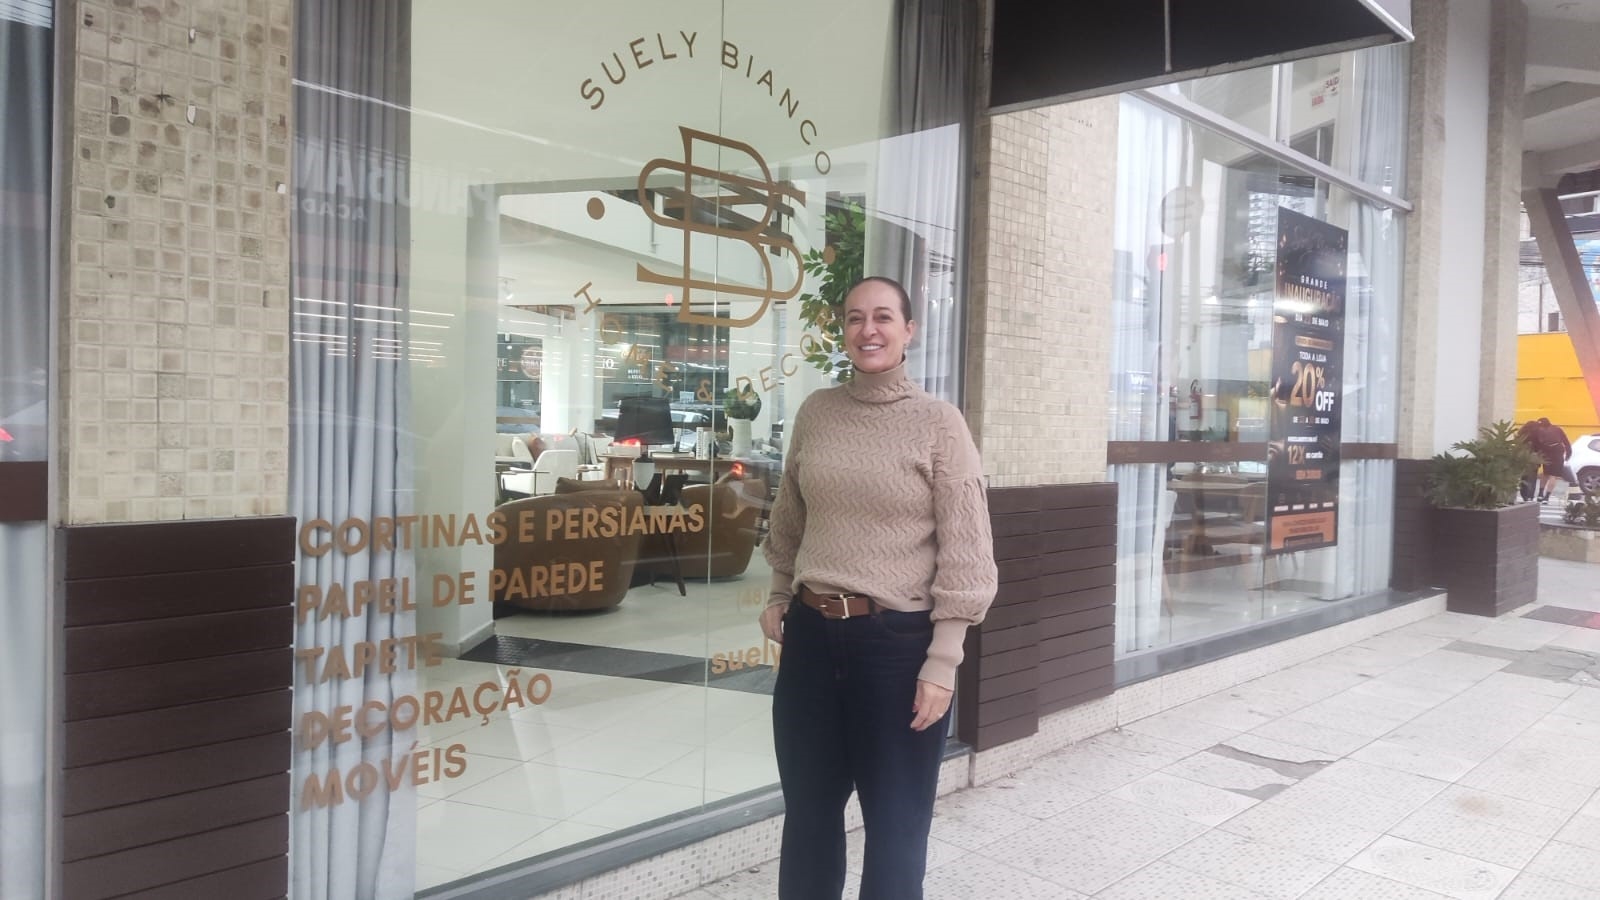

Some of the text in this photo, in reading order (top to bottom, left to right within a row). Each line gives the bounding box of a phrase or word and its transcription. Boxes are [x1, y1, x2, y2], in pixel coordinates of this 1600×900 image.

[580, 30, 831, 175] SUELY BIANCO
[1300, 275, 1328, 290] GRANDE
[573, 280, 675, 392] HOME
[696, 379, 713, 401] &
[1291, 361, 1326, 407] 20%
[1315, 390, 1334, 411] OFF
[299, 502, 705, 558] CORTINAS E PERSIANAS
[297, 560, 604, 625] PAPEL DE PAREDE
[297, 631, 443, 684] TAPETE
[301, 668, 553, 751] DECORAÇÃO
[301, 738, 468, 812] MOVÉIS
